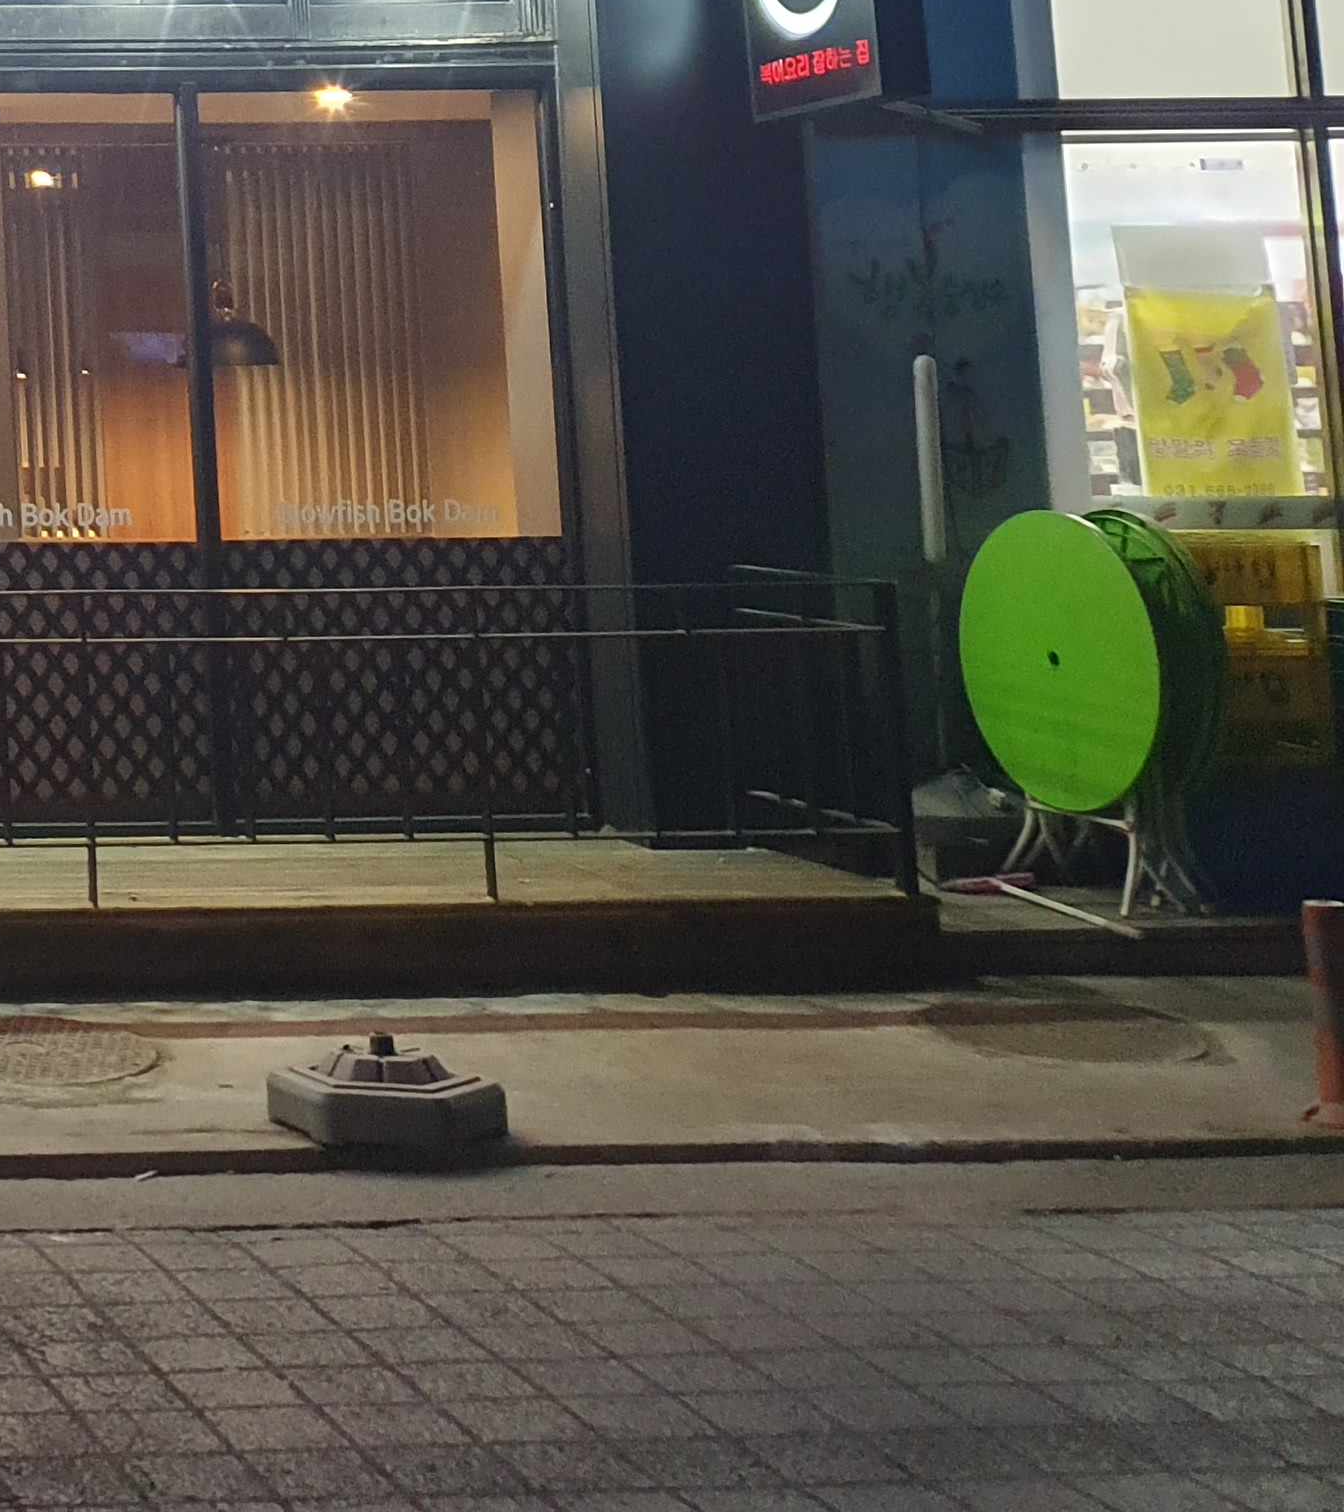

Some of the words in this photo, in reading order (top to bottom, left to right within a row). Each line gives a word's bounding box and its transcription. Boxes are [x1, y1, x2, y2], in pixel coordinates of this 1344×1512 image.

[855, 39, 870, 65] 집
[21, 502, 68, 527] Bok
[77, 502, 132, 528] Dam
[389, 499, 435, 524] Bok
[444, 499, 497, 524] Dam
